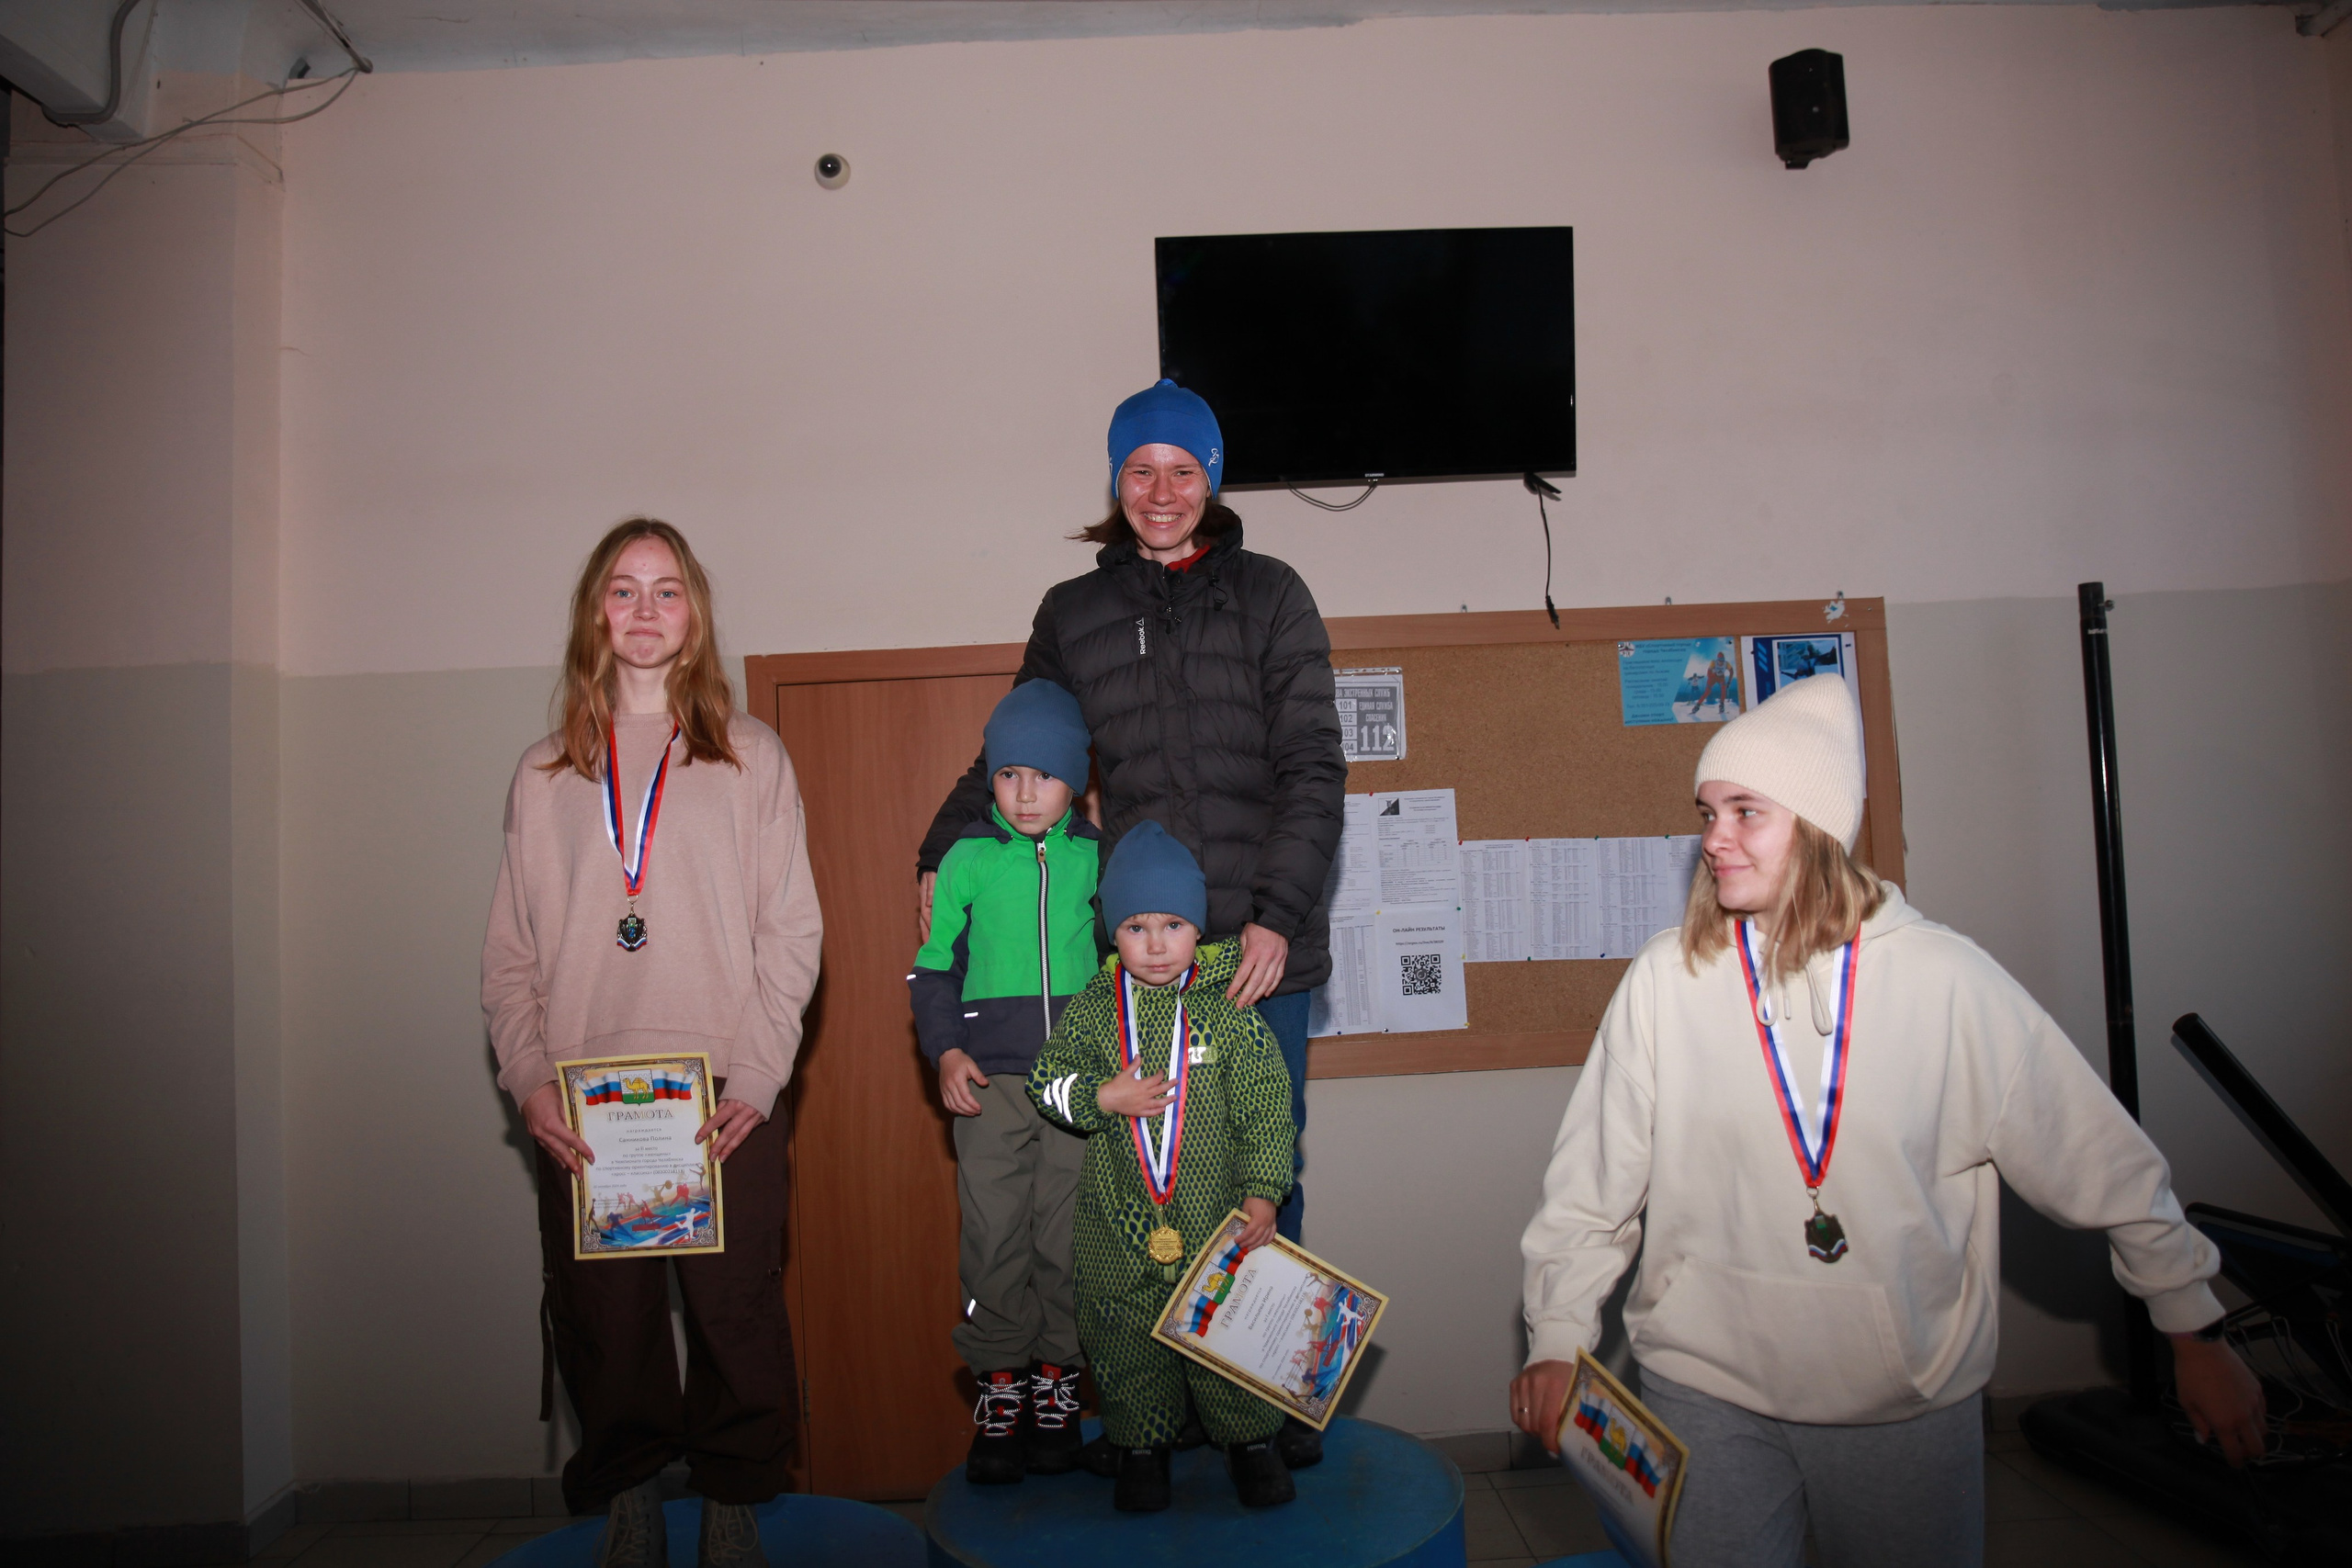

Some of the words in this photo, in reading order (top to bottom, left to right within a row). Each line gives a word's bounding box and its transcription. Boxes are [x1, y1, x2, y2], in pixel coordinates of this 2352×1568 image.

[1138, 626, 1147, 655] Reebok
[1344, 688, 1374, 698] ЭКСТРЕННЫХ
[1374, 688, 1390, 698] СЛУЖБ
[1340, 701, 1351, 710] 101
[1359, 701, 1375, 710] ЕДИНАЯ
[1375, 701, 1394, 710] СЛУЖБА
[1340, 715, 1352, 723] 102
[1365, 714, 1387, 722] СПАСЕНИЯ
[1343, 728, 1353, 738] 03
[1360, 725, 1395, 751] 112
[607, 1109, 673, 1122] ГРАМОТА
[1220, 1267, 1257, 1328] ГРАМОТА
[1283, 1286, 1297, 1309] Челябинска
[1248, 1303, 1264, 1330] Васильева
[1262, 1285, 1274, 1303] Ирина
[1262, 1337, 1278, 1363] спортивному
[1275, 1302, 1295, 1337] ориентированию
[1247, 1443, 1267, 1451] reima
